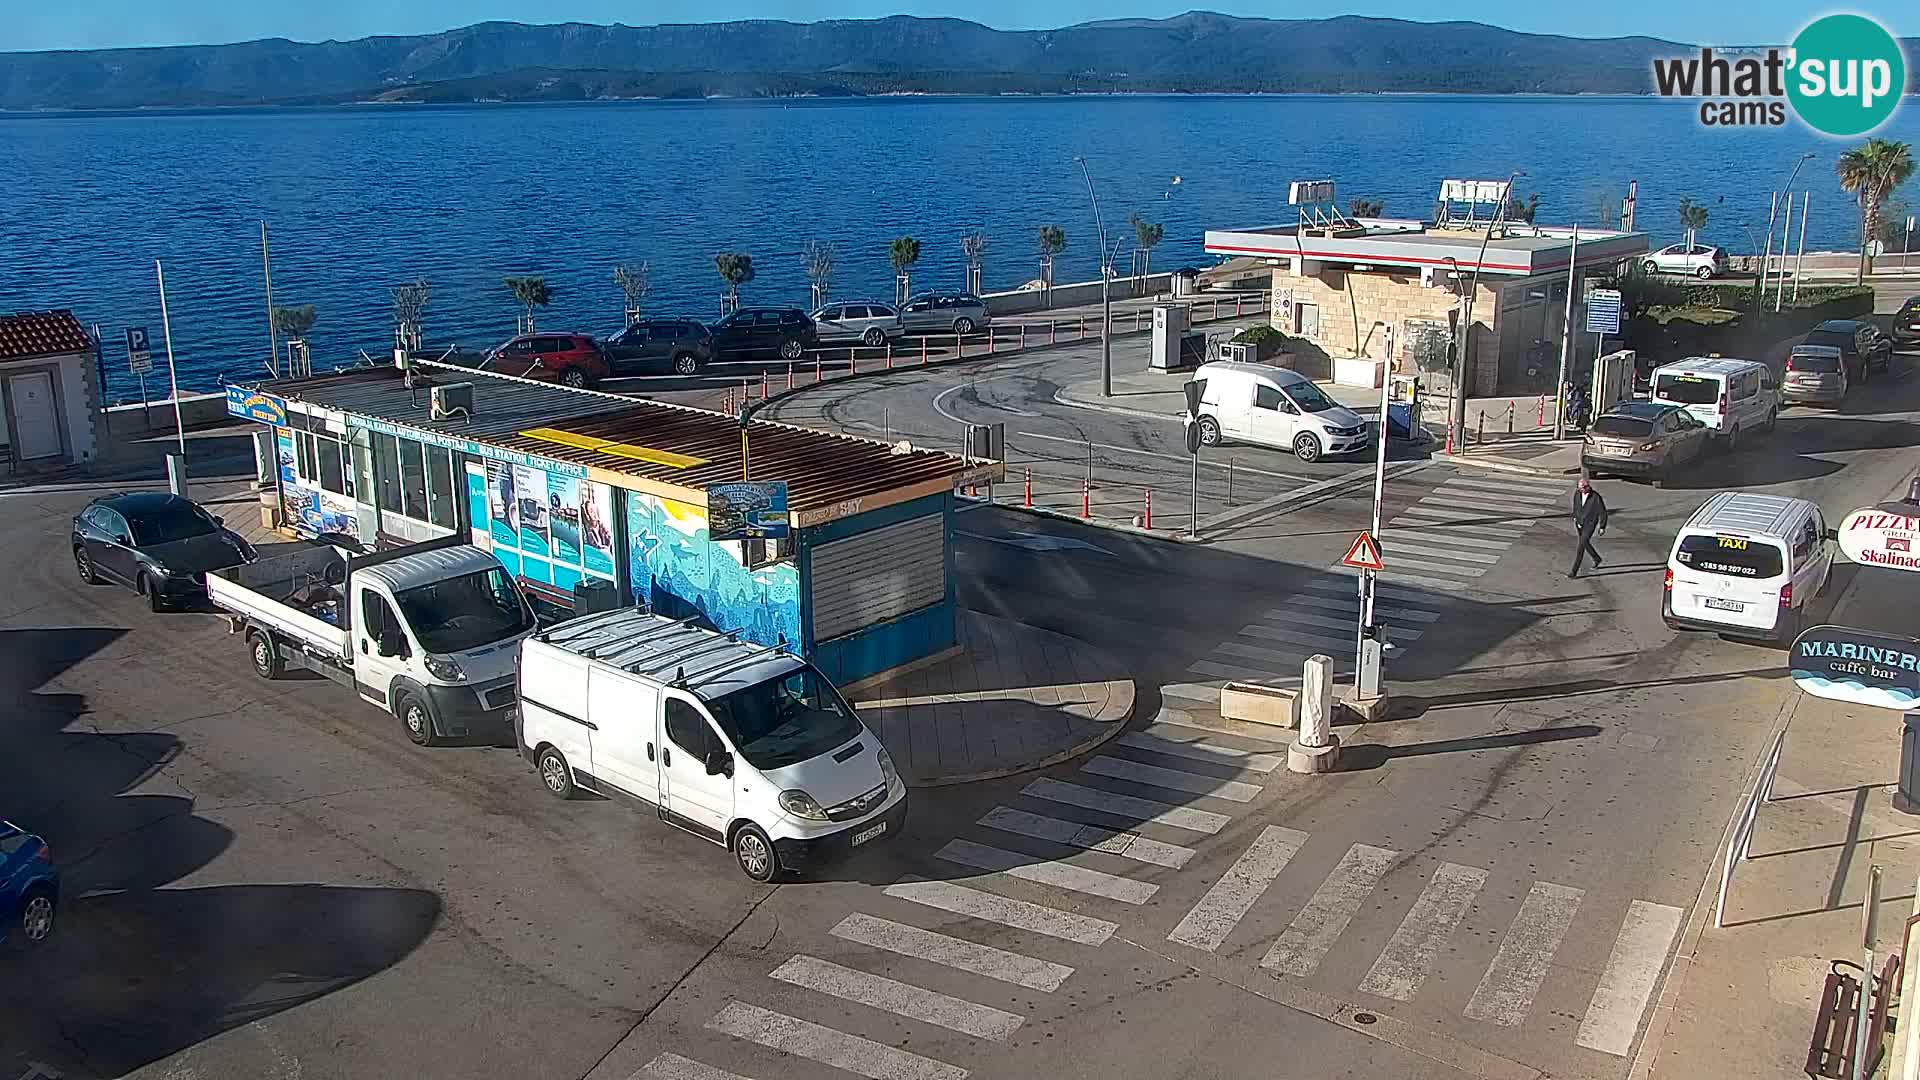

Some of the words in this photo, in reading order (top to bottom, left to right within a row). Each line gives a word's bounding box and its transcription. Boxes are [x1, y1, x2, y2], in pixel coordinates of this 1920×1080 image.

[131, 330, 144, 349] P
[495, 447, 527, 464] STATION
[530, 456, 555, 471] TICKET
[557, 462, 584, 478] OFFICE
[1848, 515, 1920, 532] PIZZE
[1728, 565, 1742, 573] 207
[1742, 567, 1757, 575] 022
[1830, 660, 1866, 675] caffe
[1871, 664, 1898, 680] bar
